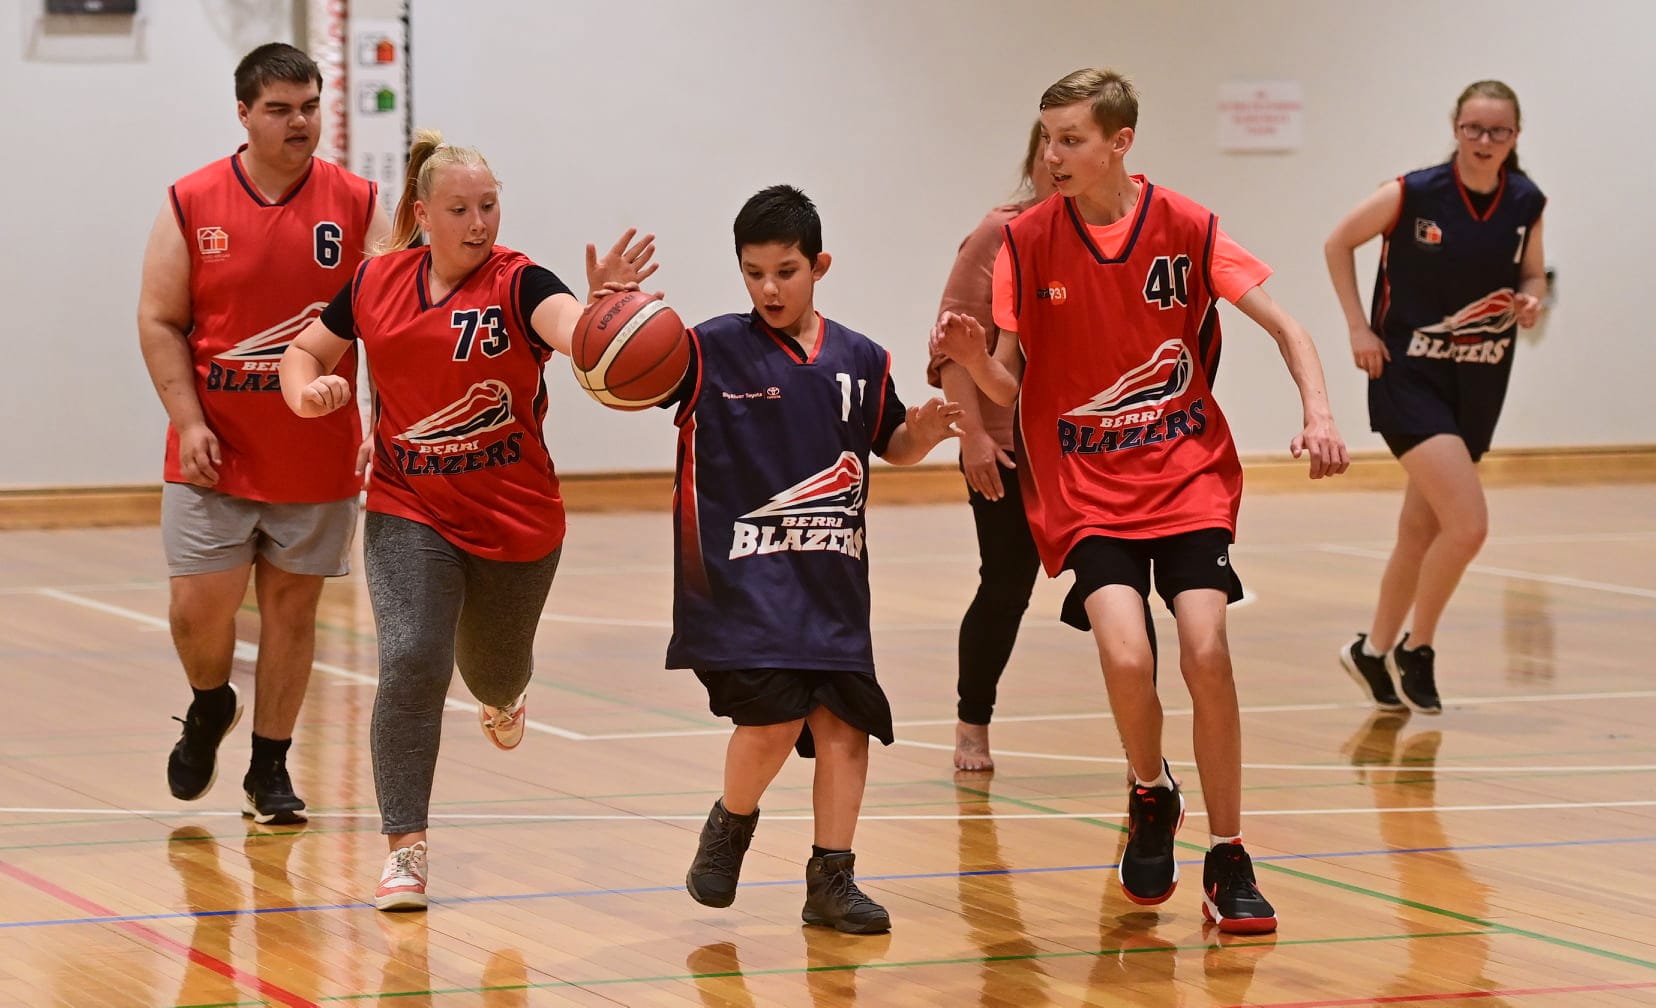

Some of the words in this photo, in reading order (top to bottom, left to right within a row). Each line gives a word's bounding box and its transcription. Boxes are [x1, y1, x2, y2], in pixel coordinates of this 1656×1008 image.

[313, 221, 343, 269] 6
[1143, 253, 1192, 311] 40
[451, 305, 511, 362] 73
[207, 360, 282, 392] BLAZ
[241, 361, 281, 371] BER
[1057, 398, 1207, 458] BLAZERS
[1099, 408, 1164, 428] BERRI
[418, 440, 480, 454] BERRI
[781, 516, 843, 527] BERRI
[728, 521, 865, 561] BLAZERS
